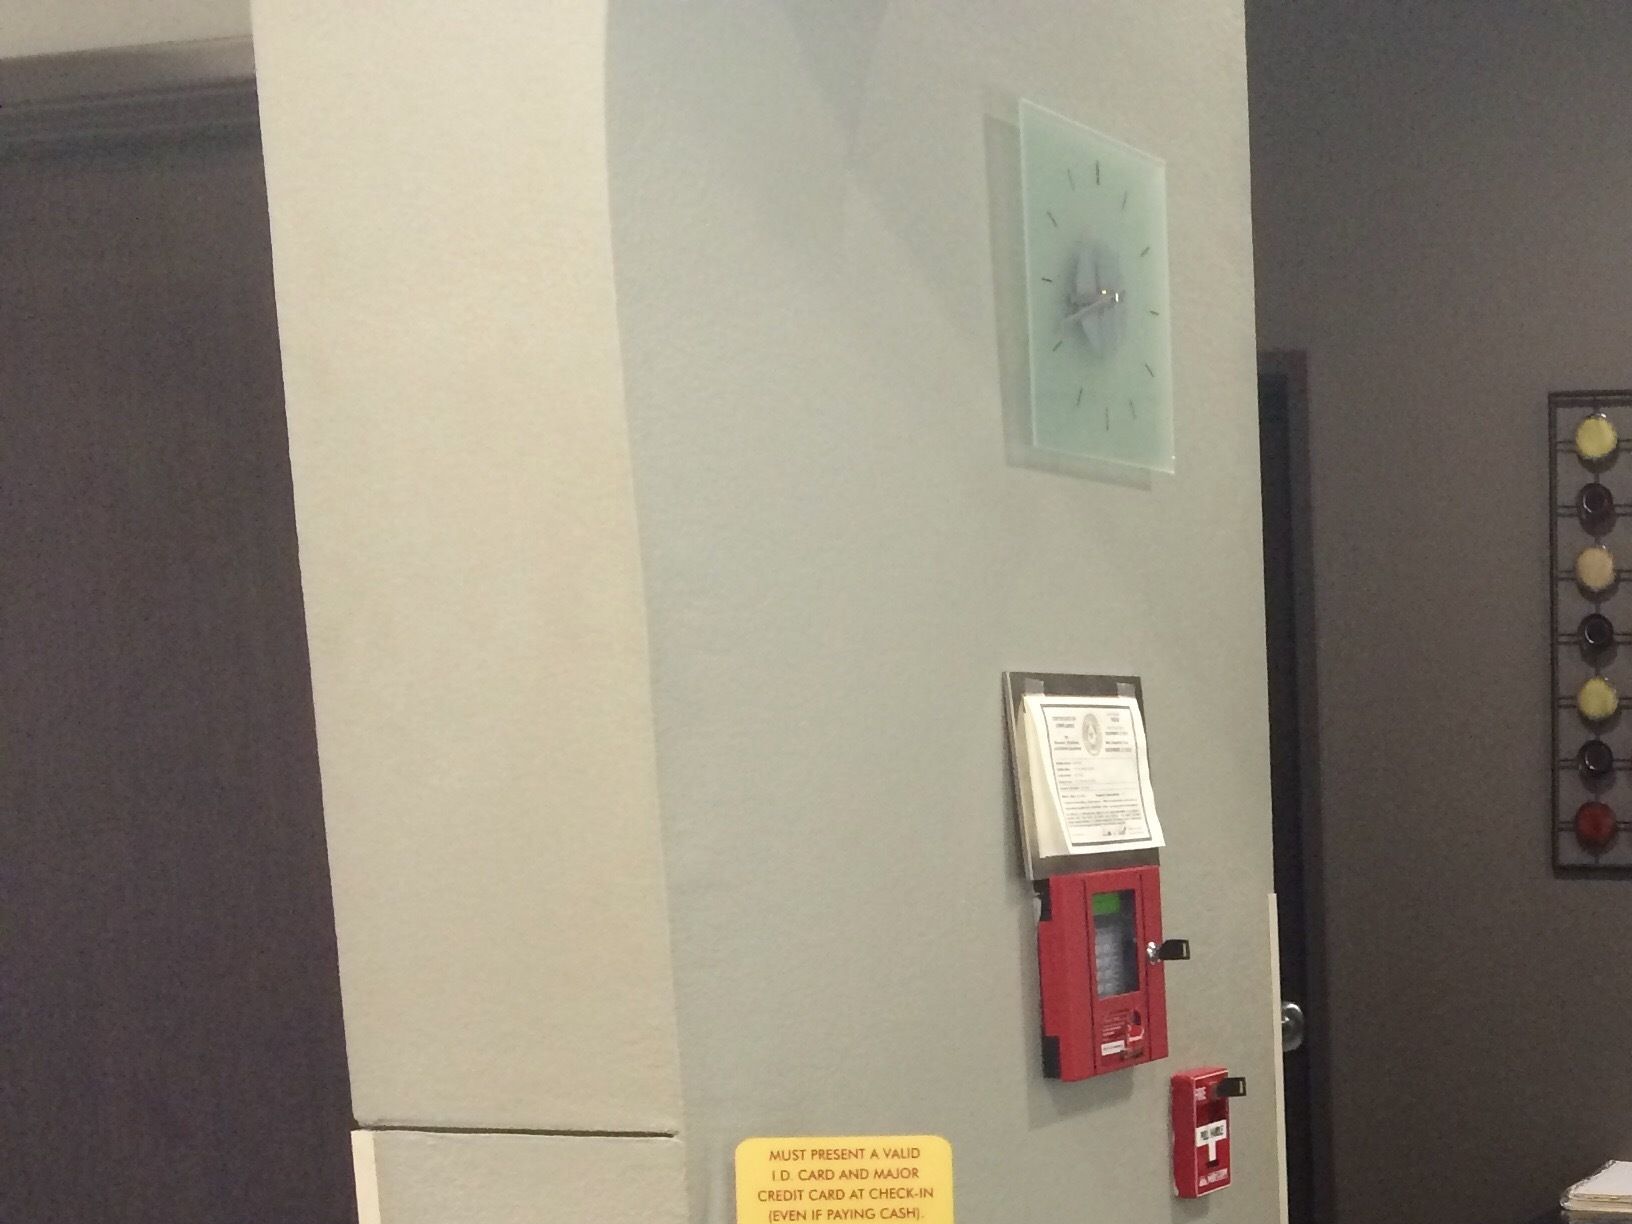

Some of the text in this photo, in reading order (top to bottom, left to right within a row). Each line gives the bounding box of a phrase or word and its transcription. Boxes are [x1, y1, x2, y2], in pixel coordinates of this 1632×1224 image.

[769, 1147, 921, 1161] MUST PRESENT A VALID
[798, 1169, 835, 1181] CARD
[838, 1168, 869, 1180] AND
[873, 1167, 920, 1180] MAJOR
[757, 1187, 934, 1202] CREDIT CARD AT CHECK-IN
[768, 1209, 807, 1224] (EVEN
[811, 1209, 823, 1221] IF
[826, 1208, 876, 1221] PAYING
